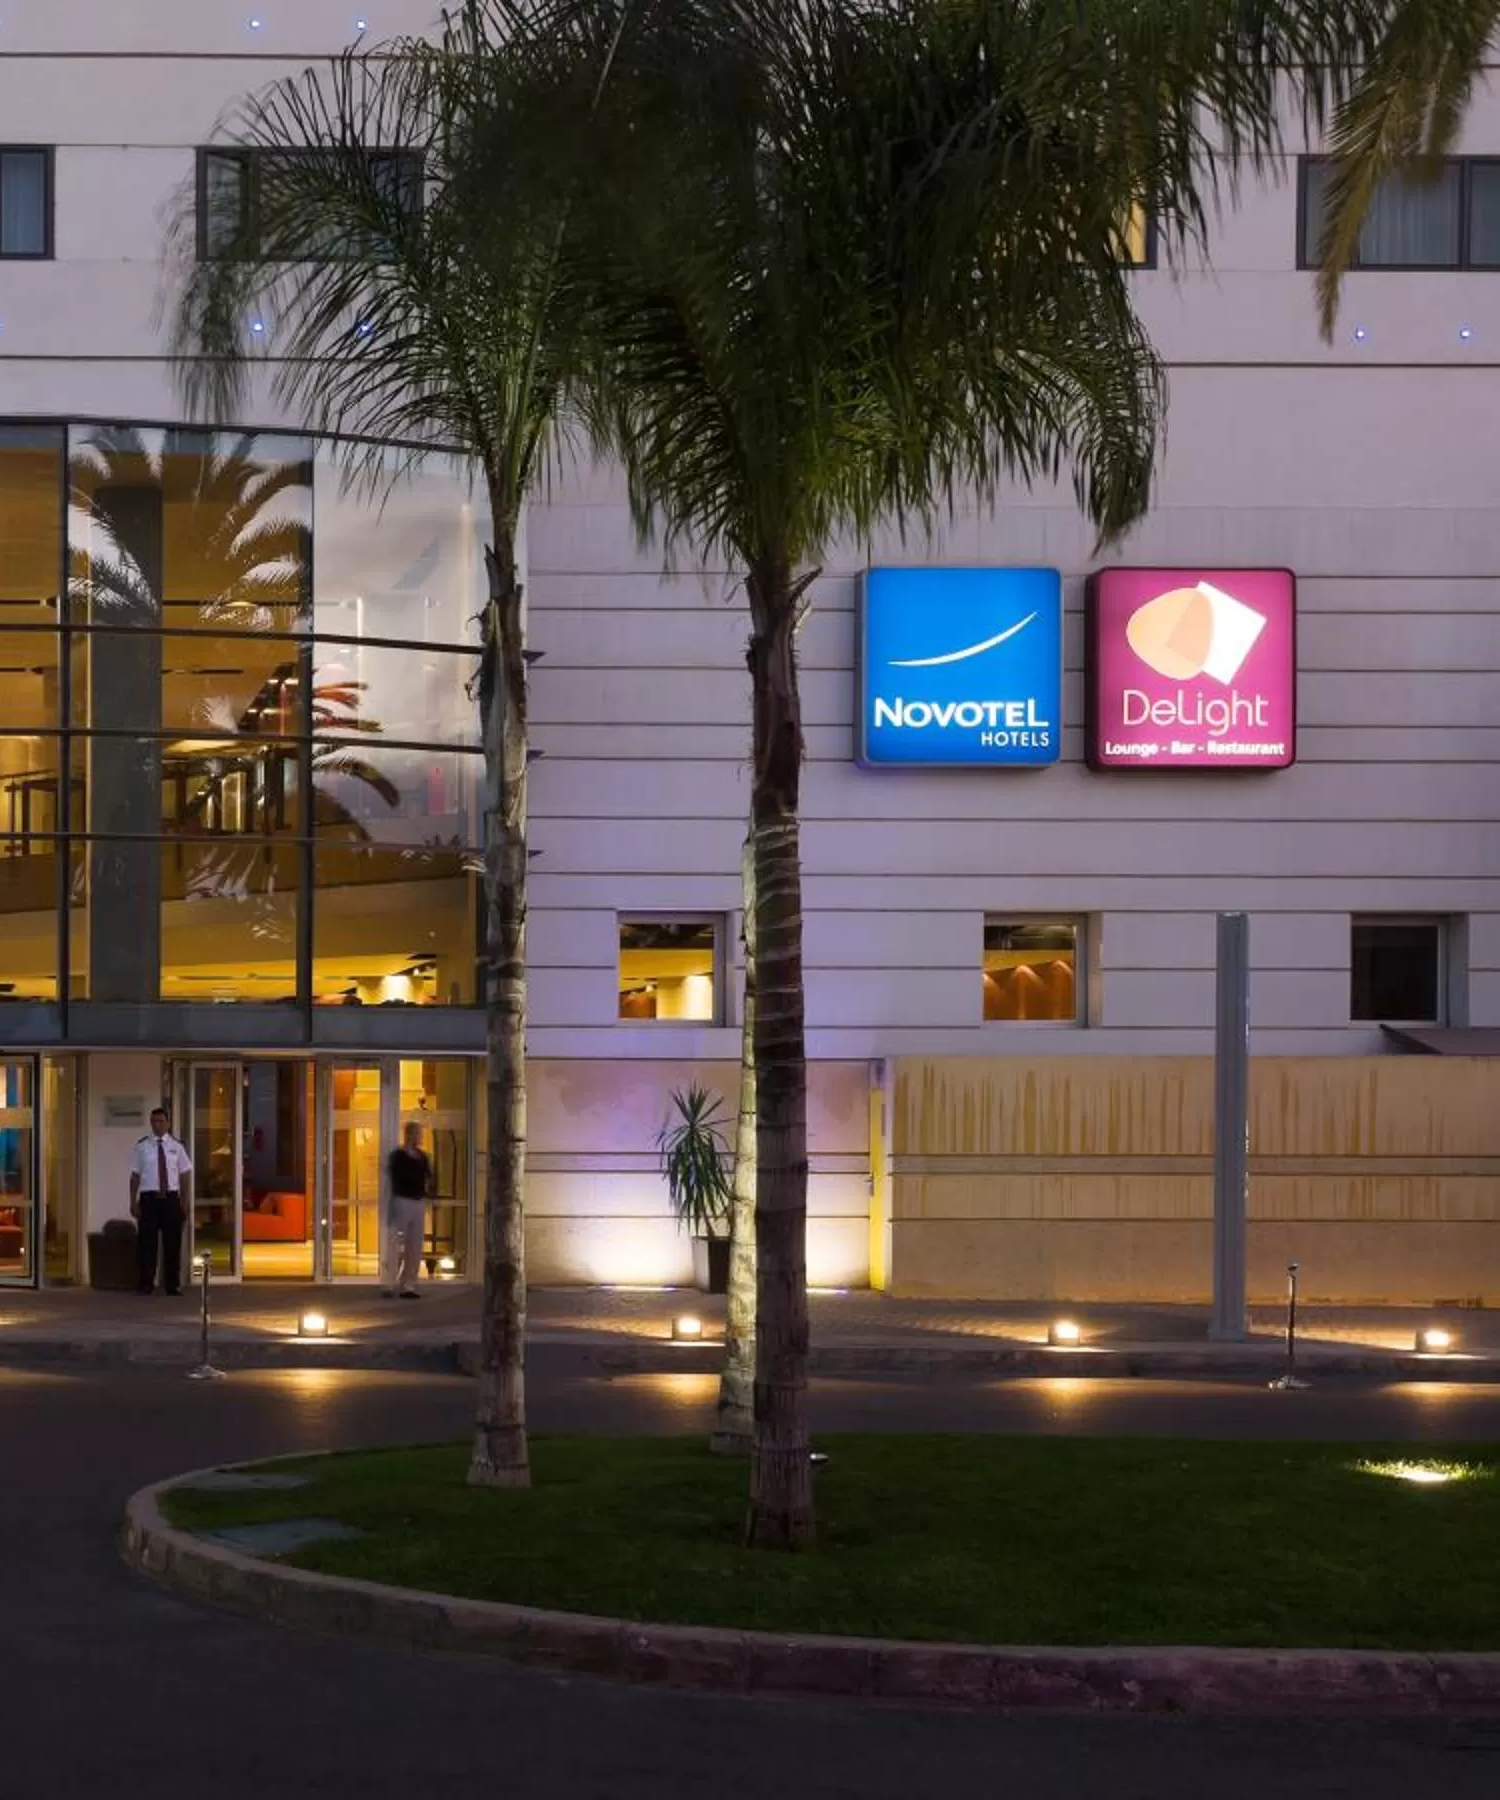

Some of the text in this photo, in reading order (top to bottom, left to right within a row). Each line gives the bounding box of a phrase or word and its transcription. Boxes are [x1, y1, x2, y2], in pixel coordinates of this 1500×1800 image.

[874, 697, 1050, 728] NOVOTEL
[1123, 689, 1269, 736] DeLight
[980, 731, 1050, 747] HOTELS
[1105, 740, 1160, 757] Lounge
[1170, 740, 1197, 755] Bar
[1207, 740, 1285, 756] Restaurant
